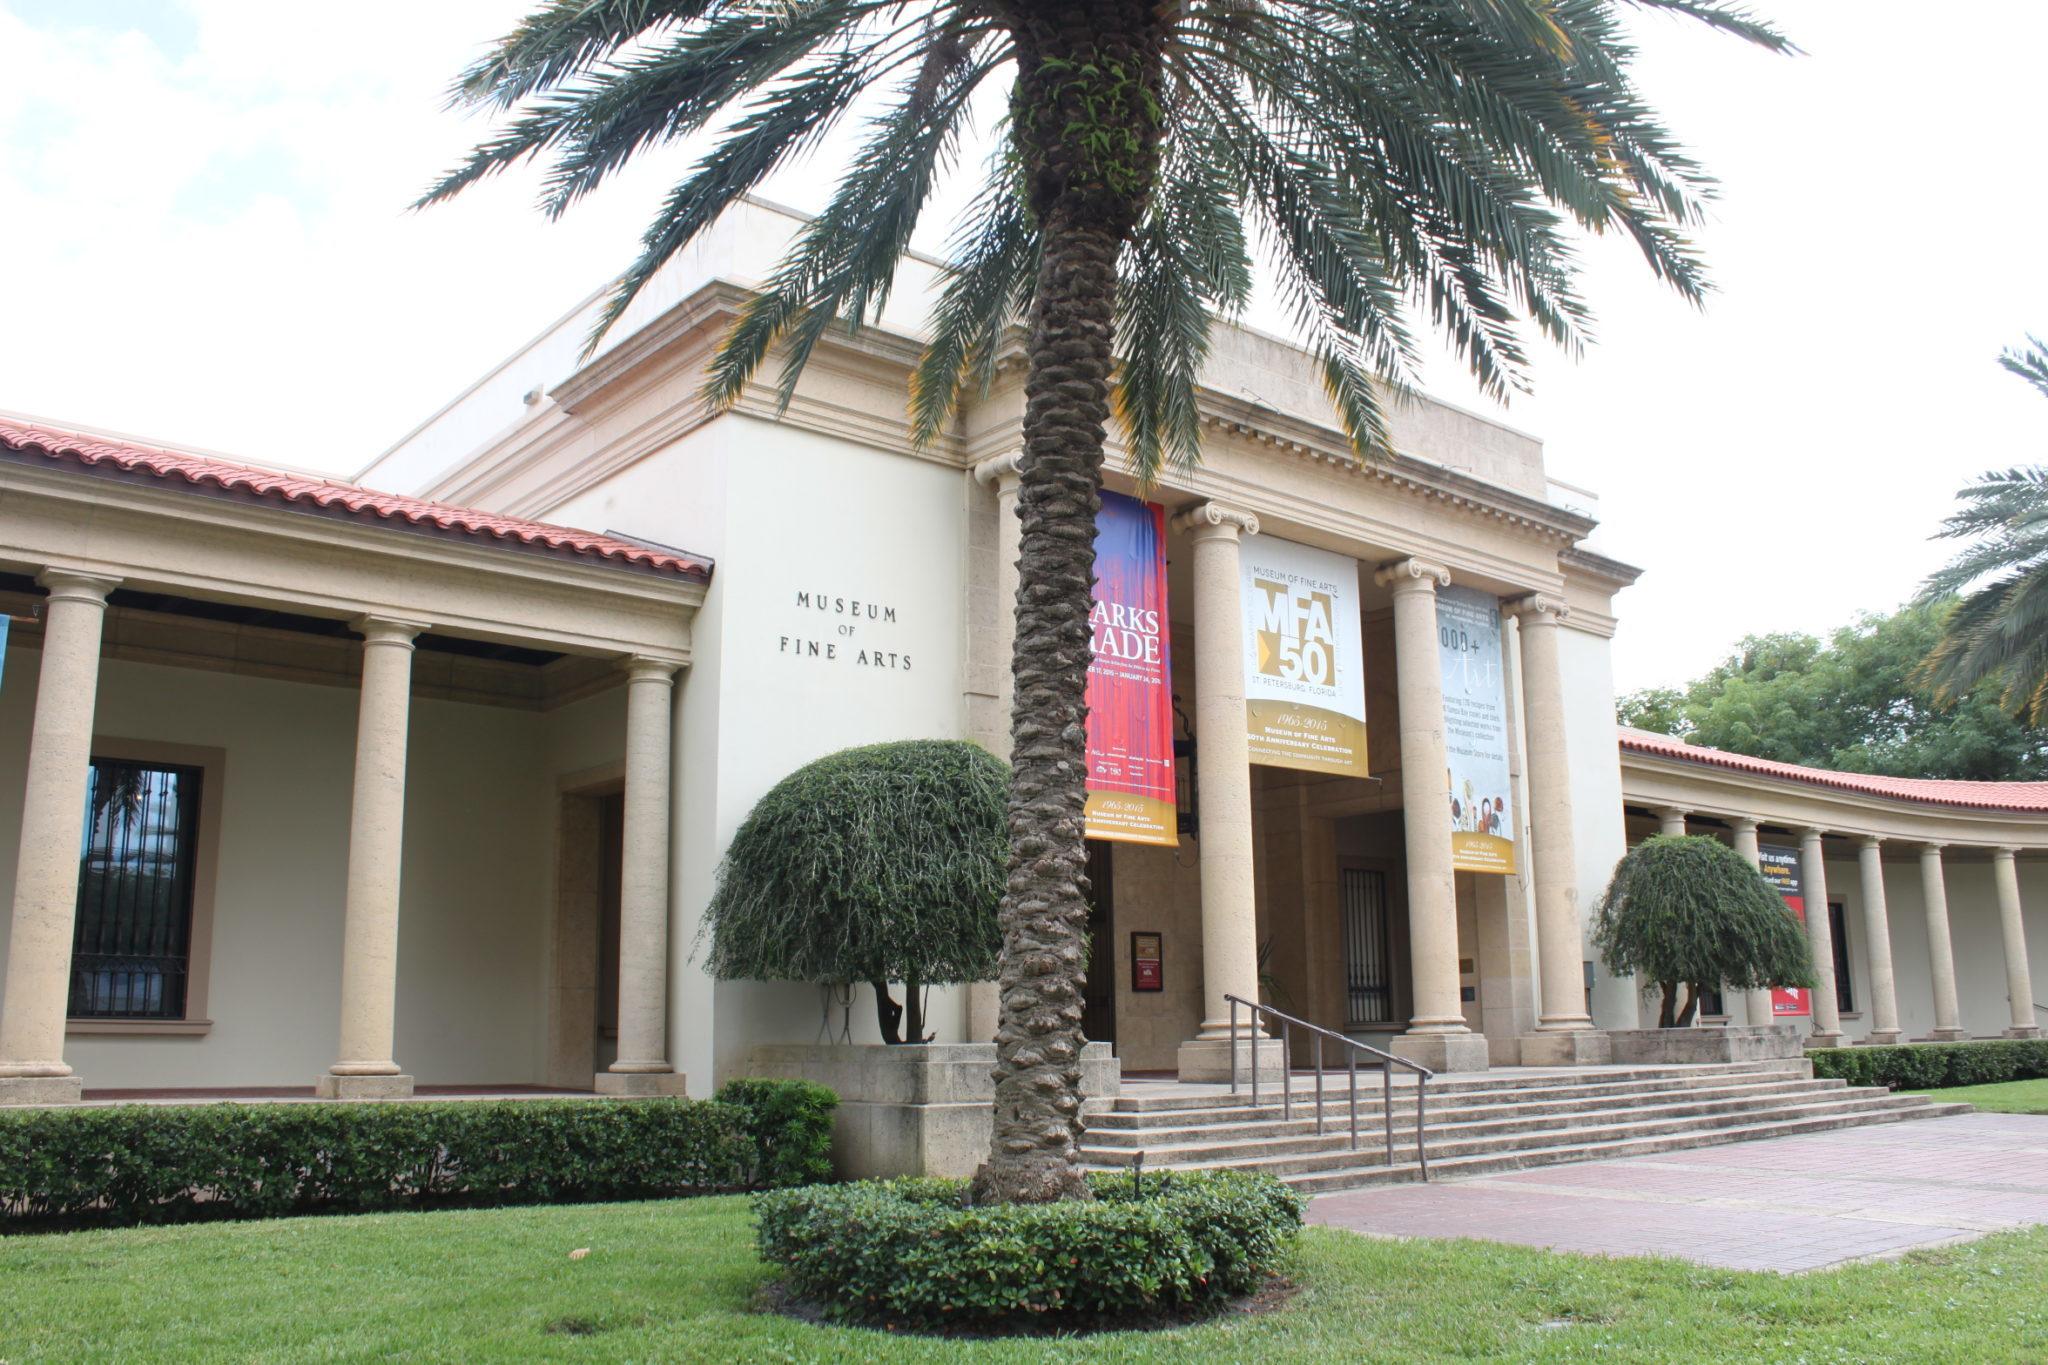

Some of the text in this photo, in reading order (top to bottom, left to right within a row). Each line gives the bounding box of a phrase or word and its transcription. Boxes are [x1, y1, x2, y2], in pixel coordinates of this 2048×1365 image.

[1253, 566, 1338, 593] MUSEUM OF FINE ARTS
[797, 591, 896, 622] MUSEUM
[1089, 600, 1159, 635] ARKS
[1254, 582, 1334, 646] MFA
[838, 625, 855, 636] OF
[780, 637, 911, 670] FINE ARTS
[1279, 633, 1328, 685] 50
